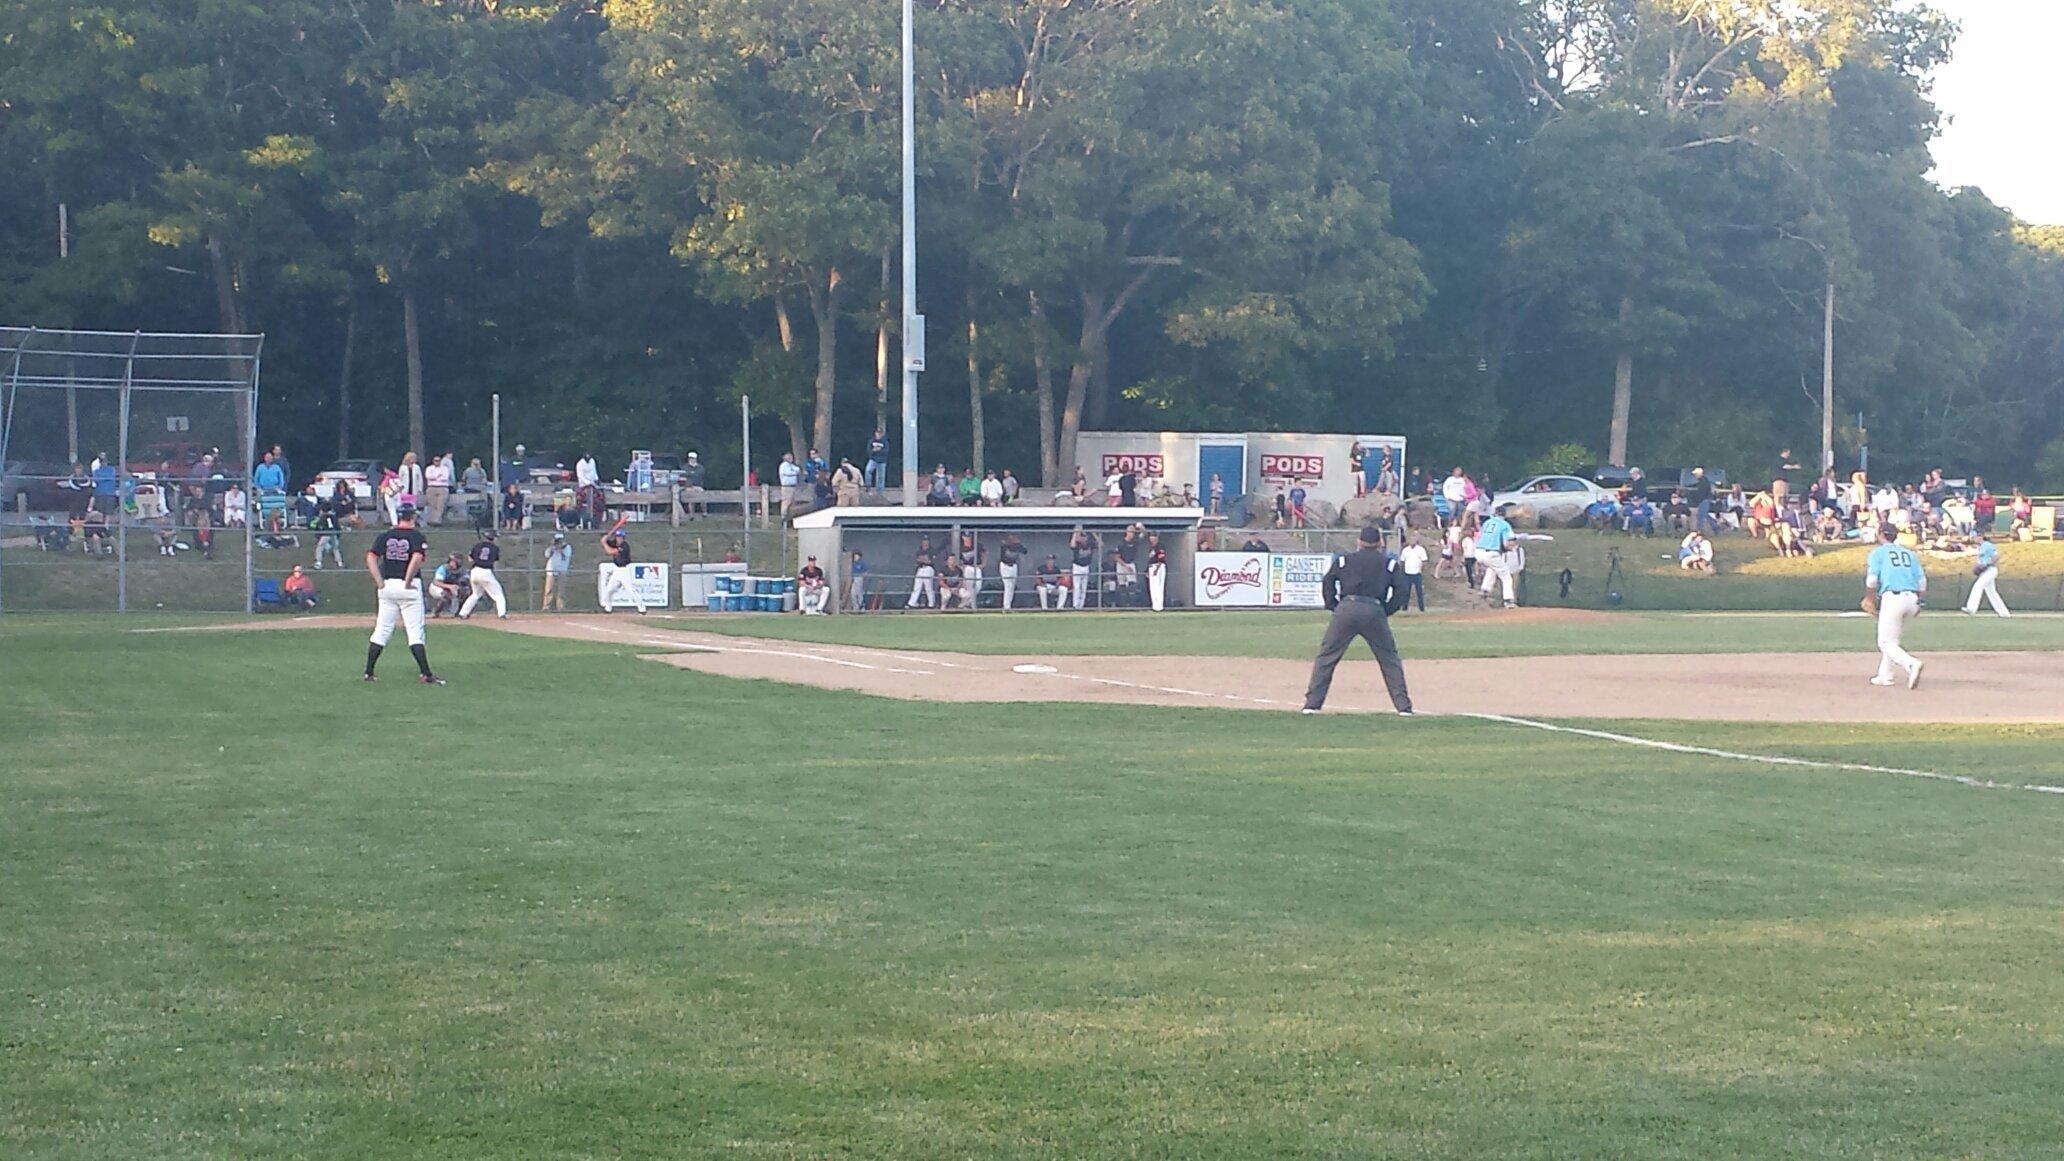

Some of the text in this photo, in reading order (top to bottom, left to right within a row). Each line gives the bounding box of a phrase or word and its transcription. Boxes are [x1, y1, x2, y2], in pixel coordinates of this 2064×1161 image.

[1104, 456, 1163, 472] PODS
[1262, 456, 1322, 473] PODS
[386, 538, 410, 560] 22
[1889, 551, 1912, 568] 20
[1201, 567, 1261, 586] Diamond
[1286, 573, 1323, 582] RIDES
